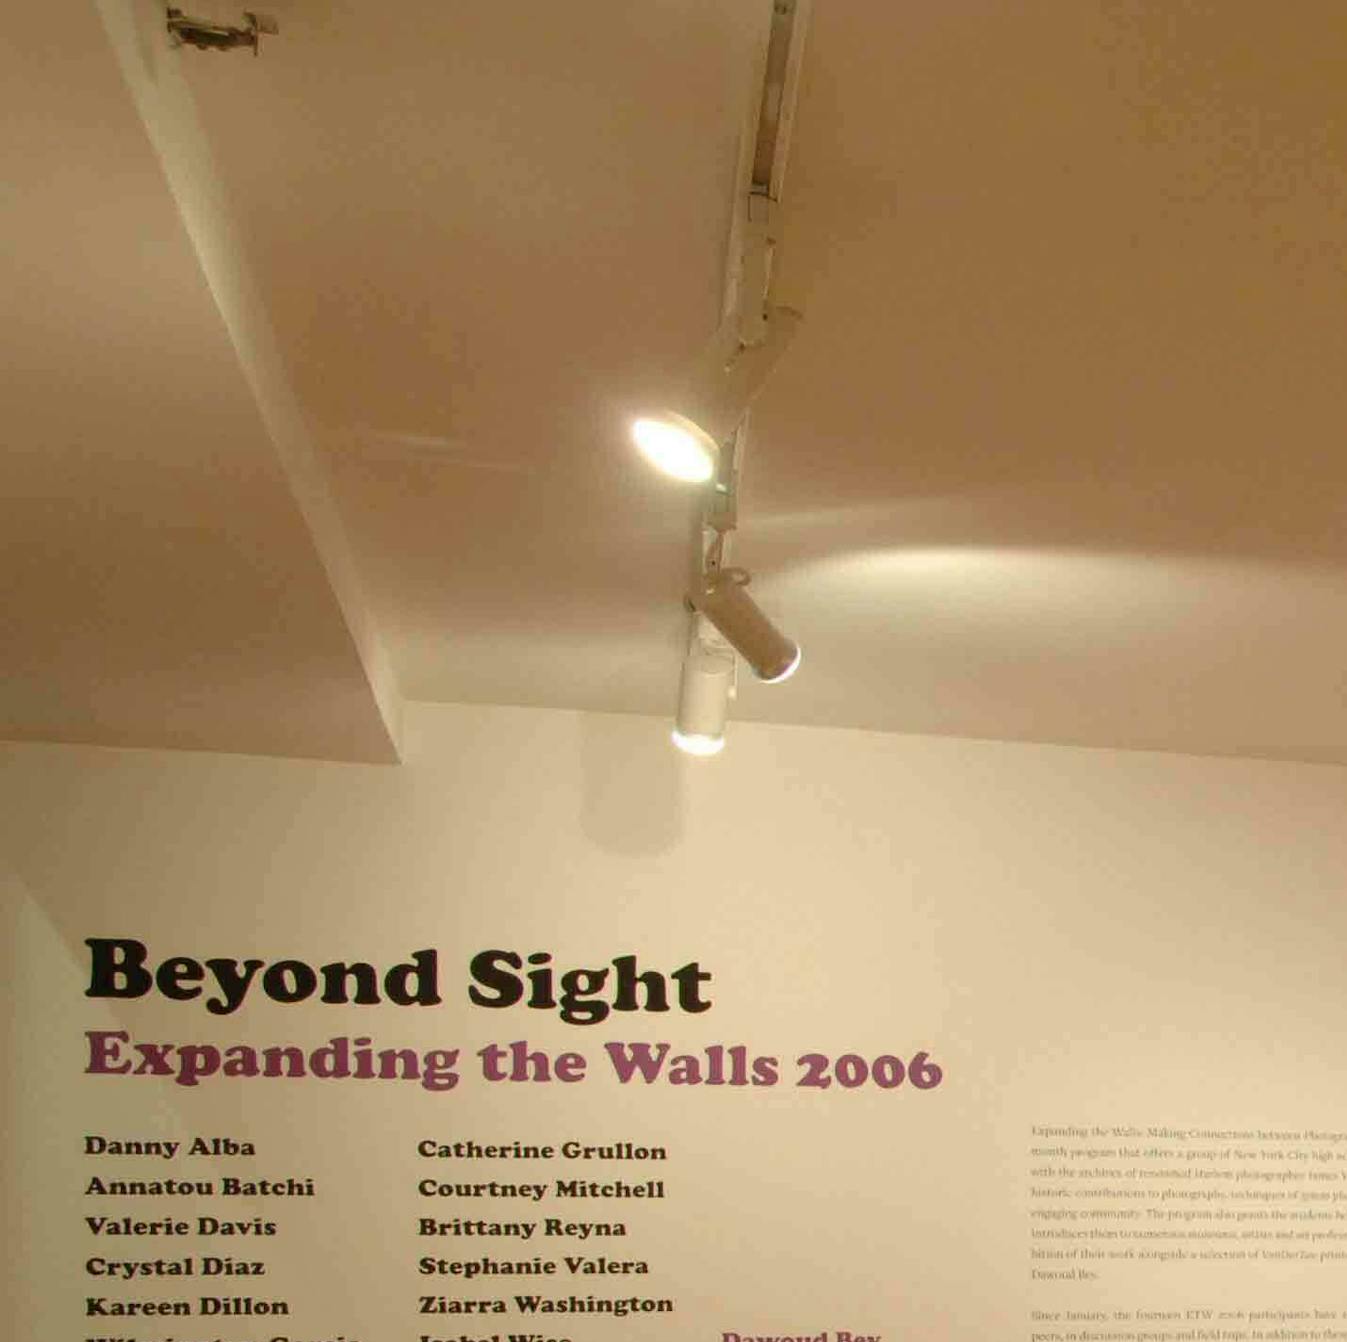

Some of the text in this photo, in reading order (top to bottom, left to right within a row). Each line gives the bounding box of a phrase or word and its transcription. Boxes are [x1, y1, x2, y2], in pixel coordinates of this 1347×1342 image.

[85, 938, 711, 1025] Beyond Sight
[85, 1031, 942, 1091] Expanding the Walls 2006
[85, 1136, 255, 1159] Danny Alba
[418, 1141, 666, 1159] Catherine Grullon
[85, 1177, 314, 1196] Annatou Batchi
[419, 1179, 664, 1201] Courtney Mitchell
[85, 1217, 276, 1235] Valerie Davis
[419, 1219, 626, 1239] Brittany Reyna
[86, 1258, 265, 1279] Crystal Diaz
[419, 1257, 648, 1278] Stephanie Valera
[86, 1298, 288, 1316] Kareen Dillon
[419, 1296, 672, 1316] Ziarra Washington
